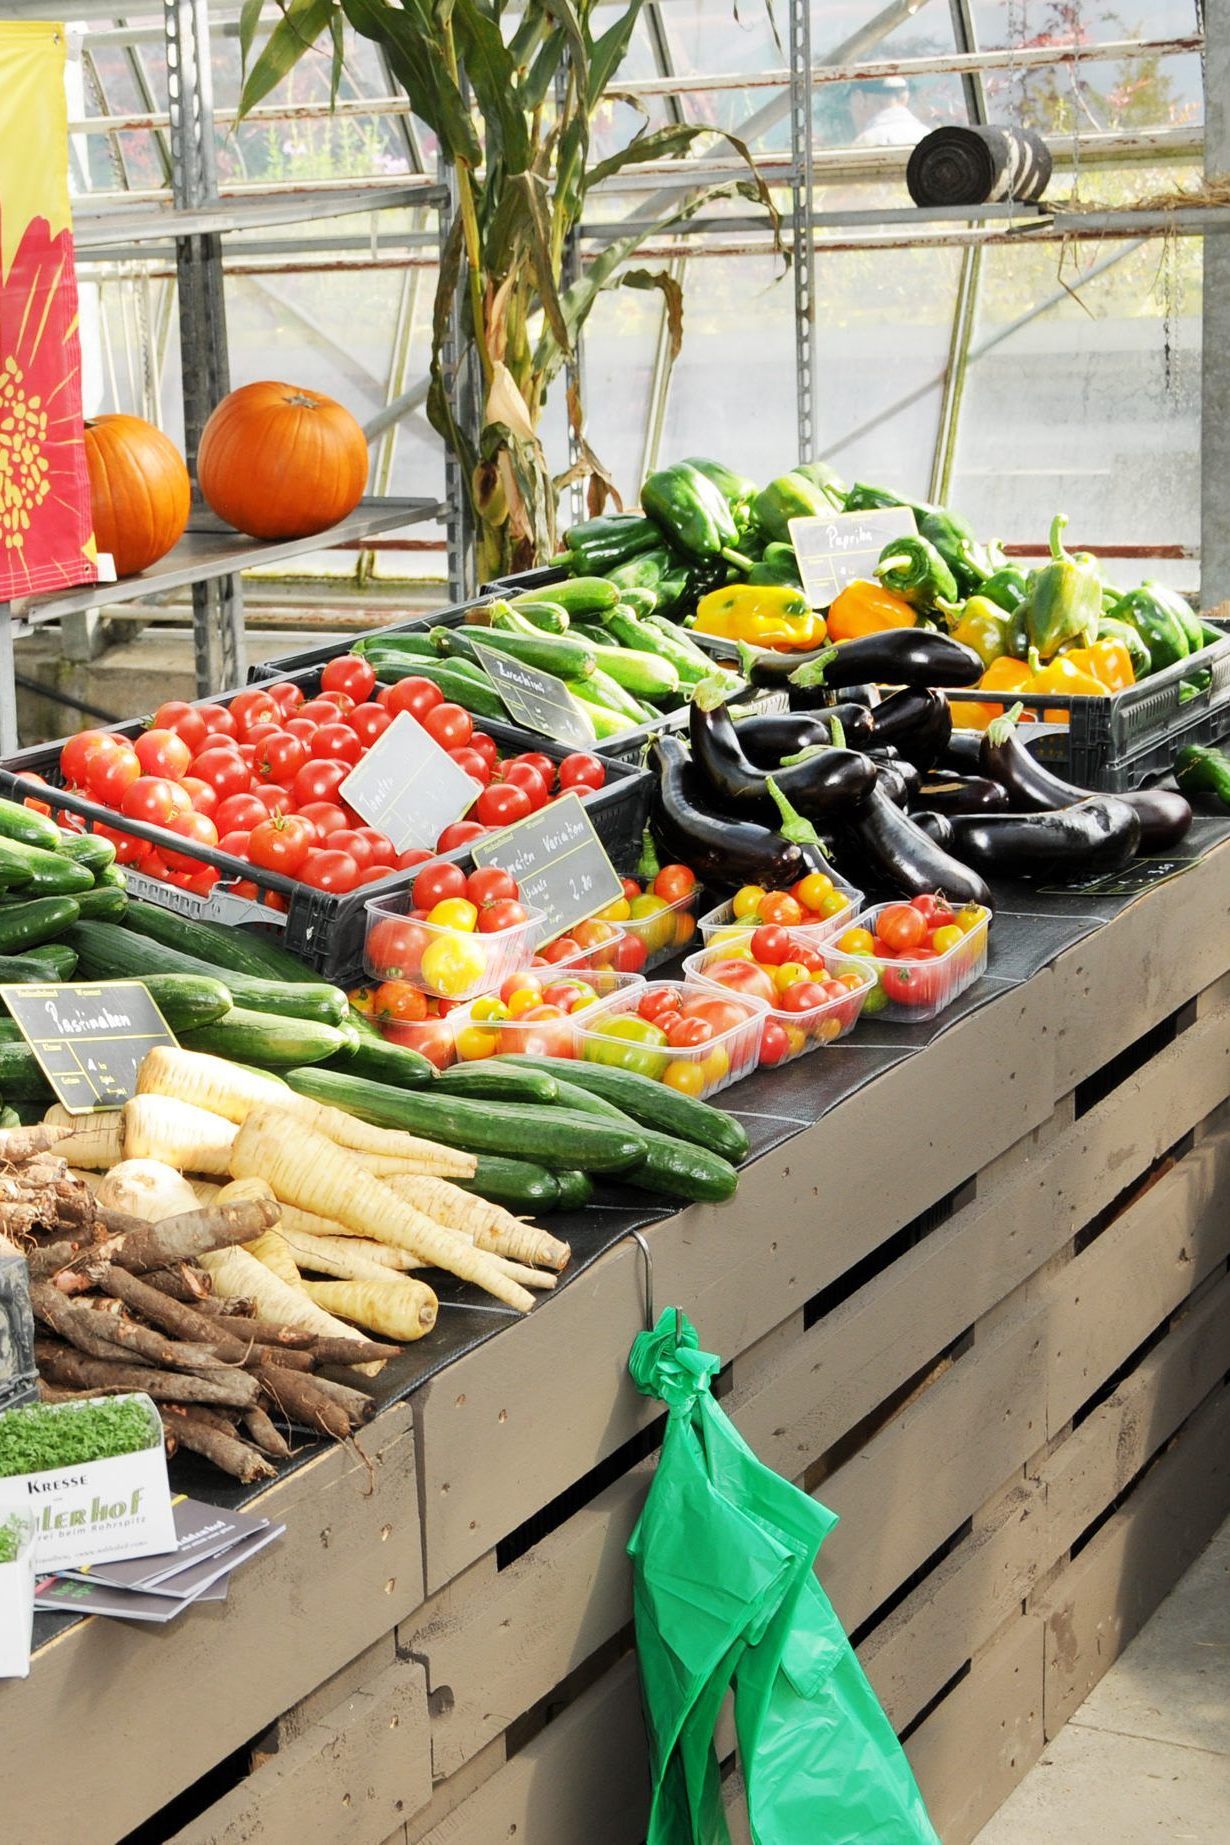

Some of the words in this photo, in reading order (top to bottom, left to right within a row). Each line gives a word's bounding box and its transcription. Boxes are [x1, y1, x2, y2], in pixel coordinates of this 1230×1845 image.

[489, 849, 535, 875] Tmaten
[58, 1528, 87, 1539] beim
[91, 1517, 147, 1532] Rohrspitz
